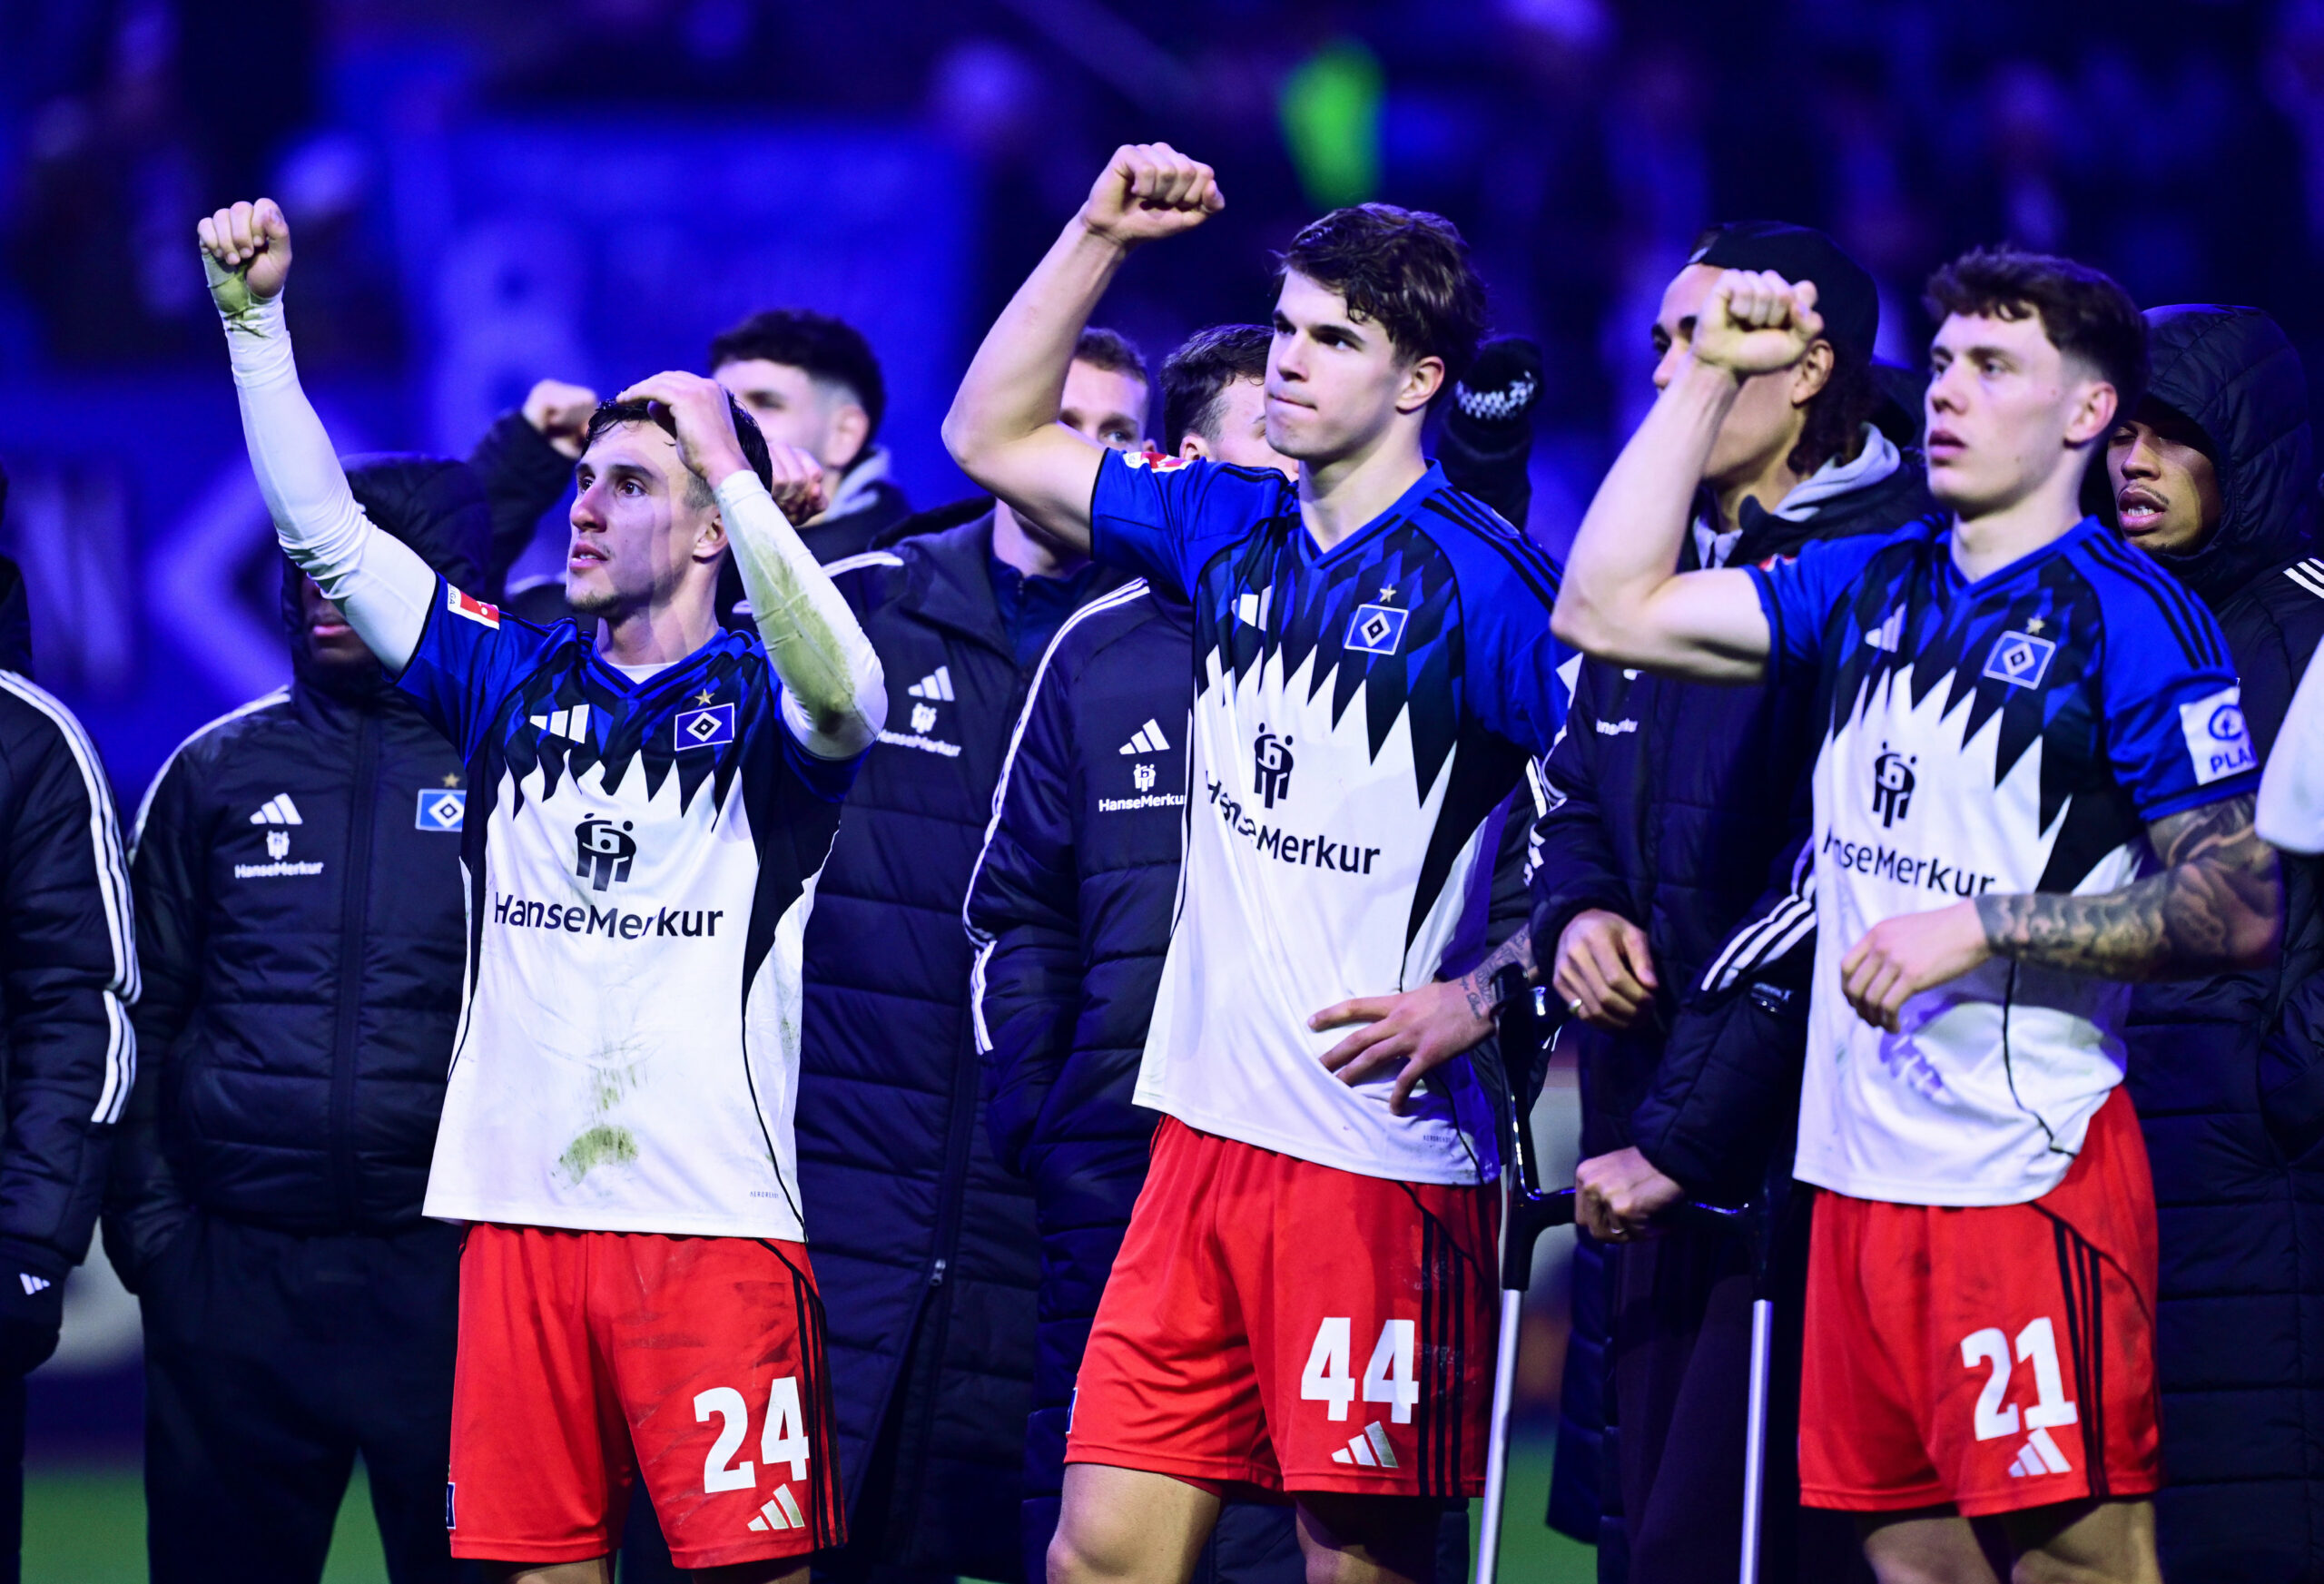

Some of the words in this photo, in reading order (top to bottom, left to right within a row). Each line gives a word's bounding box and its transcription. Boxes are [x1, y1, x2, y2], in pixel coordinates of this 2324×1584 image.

[1823, 824, 1995, 897] seMerkur
[494, 891, 724, 940] HanseMerkur
[1300, 1316, 1419, 1424] 44
[1960, 1317, 2078, 1441] 21
[694, 1376, 811, 1493] 24
